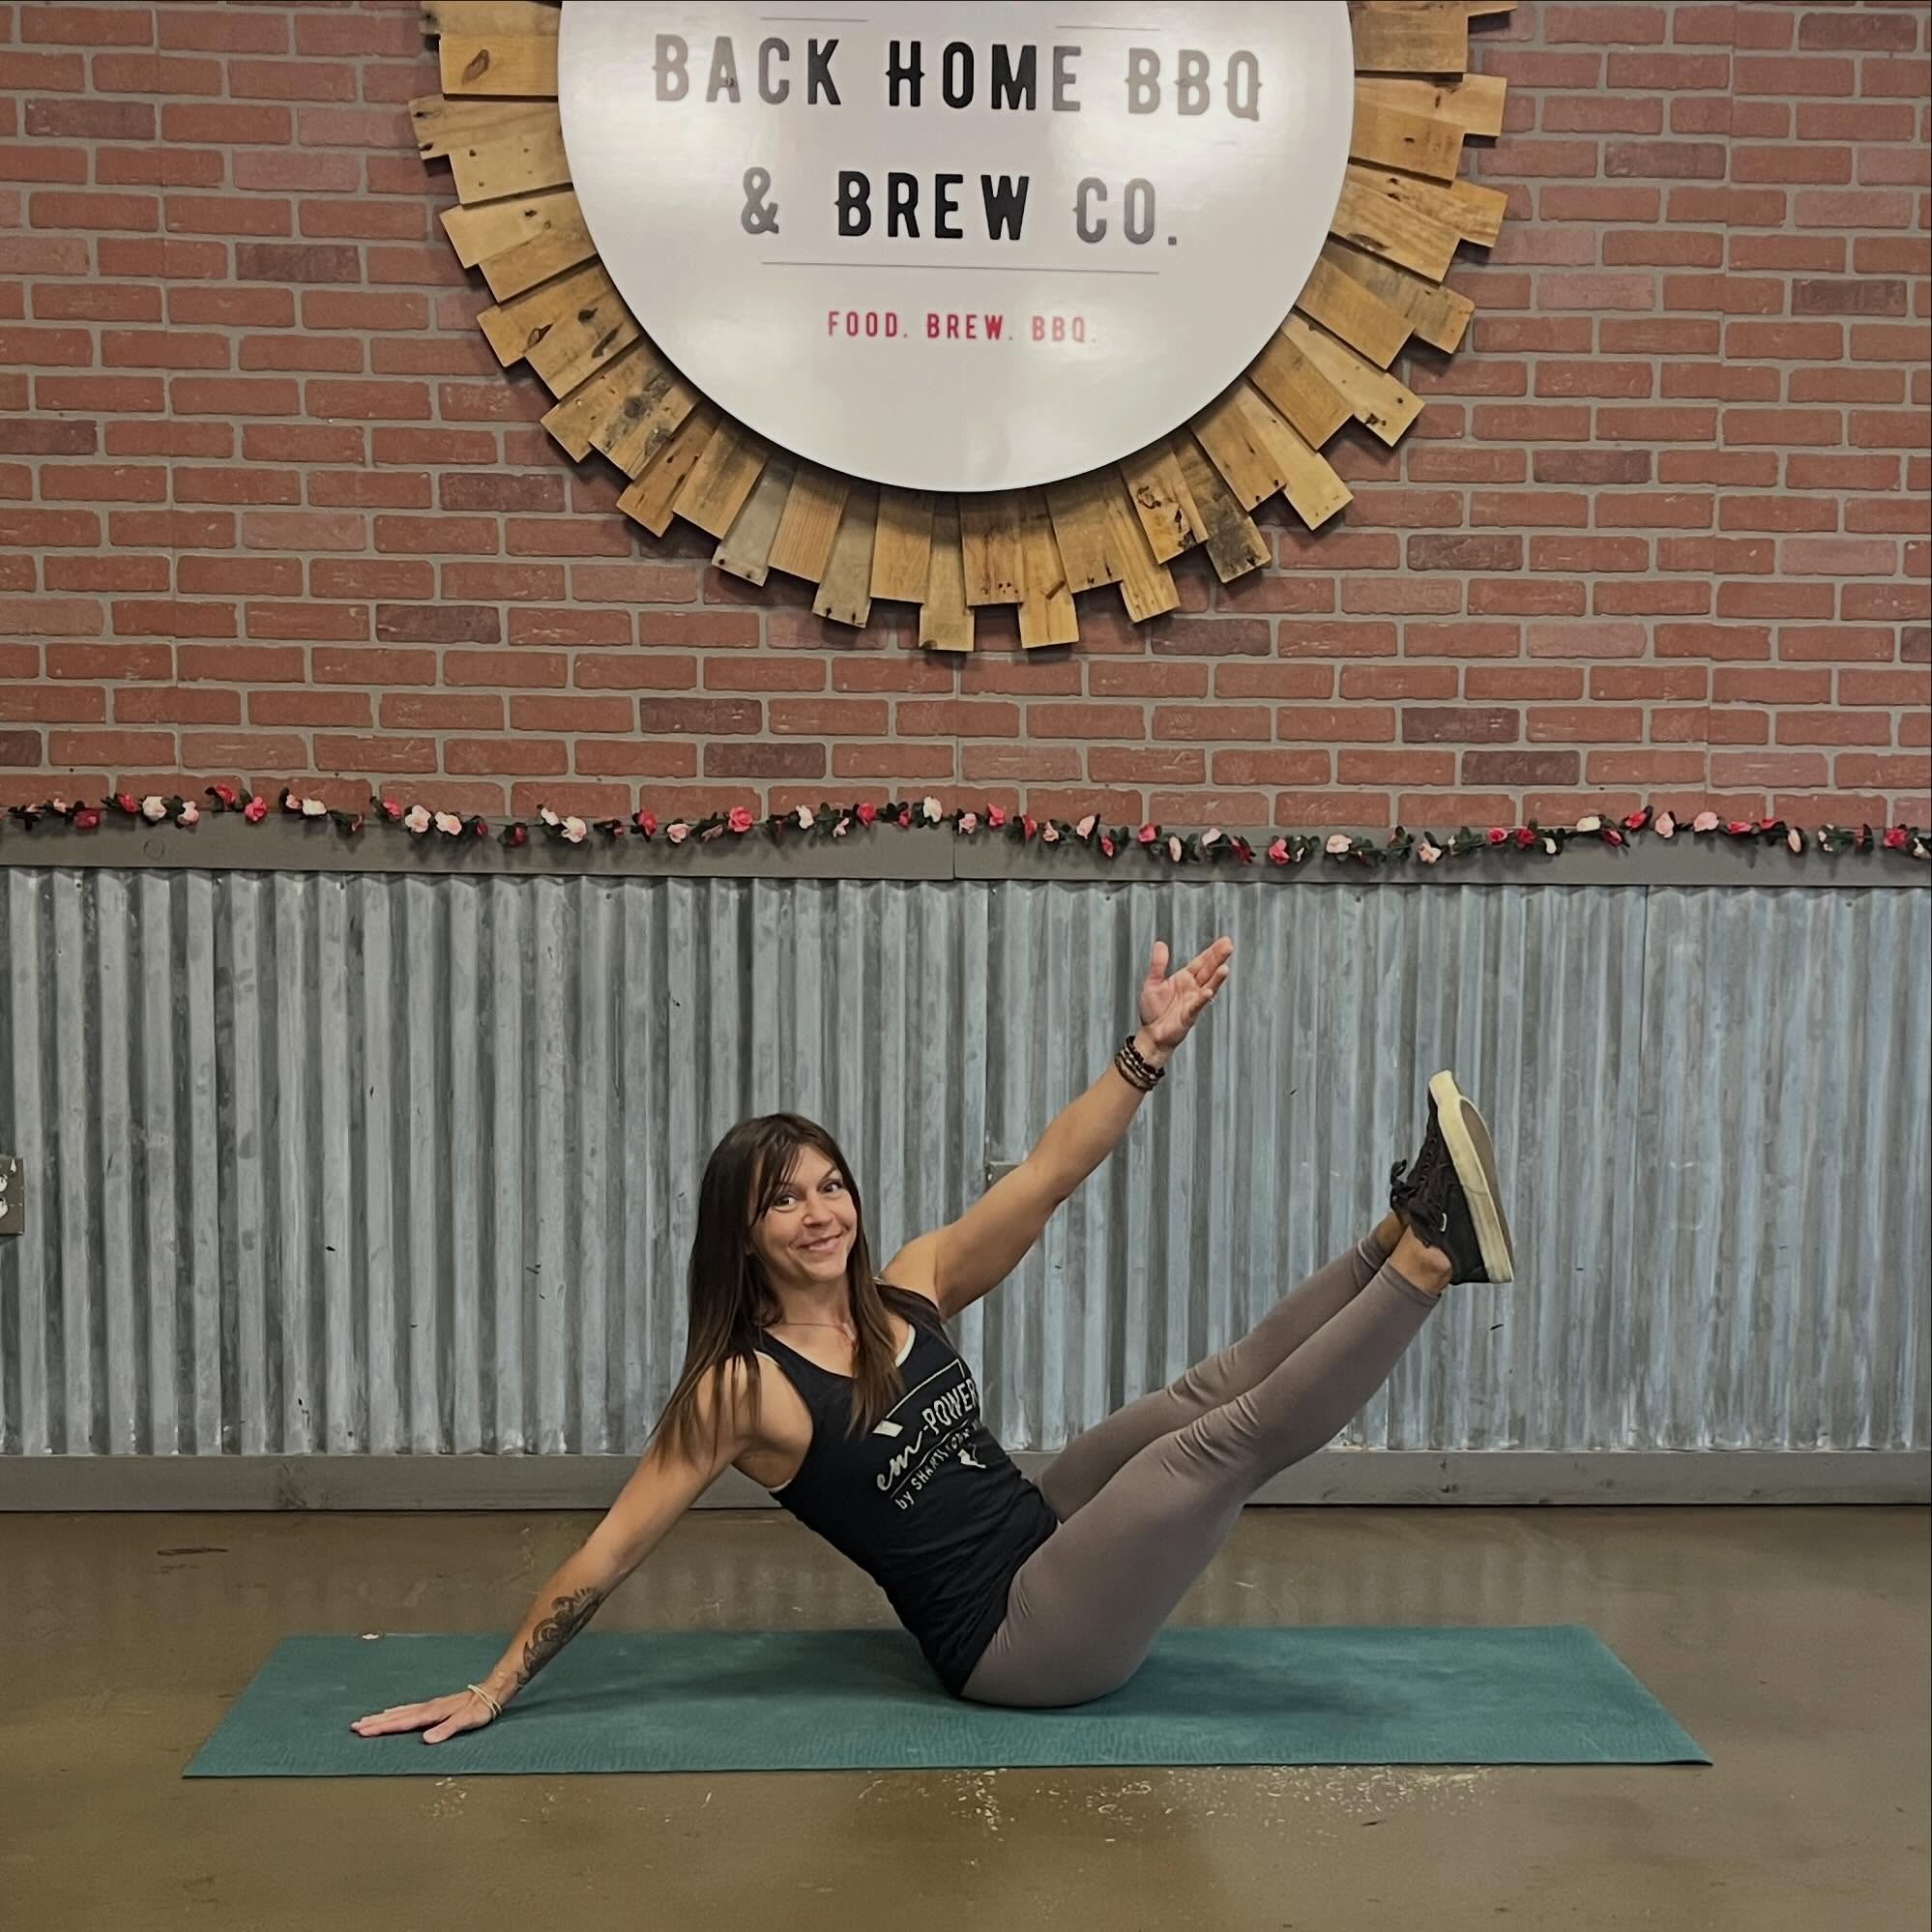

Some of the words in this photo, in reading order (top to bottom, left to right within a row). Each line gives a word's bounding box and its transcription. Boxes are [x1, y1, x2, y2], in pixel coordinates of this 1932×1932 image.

[651, 33, 842, 106] BACK
[884, 39, 1082, 113] HOME
[1124, 46, 1264, 123] BBQ
[740, 166, 780, 236] &
[833, 169, 1031, 242] BREW
[1071, 176, 1178, 247] CO.
[827, 310, 908, 338] FOOD.
[925, 312, 1013, 341] BREW.
[1031, 314, 1097, 344] BBQ.
[894, 1491, 915, 1509] by
